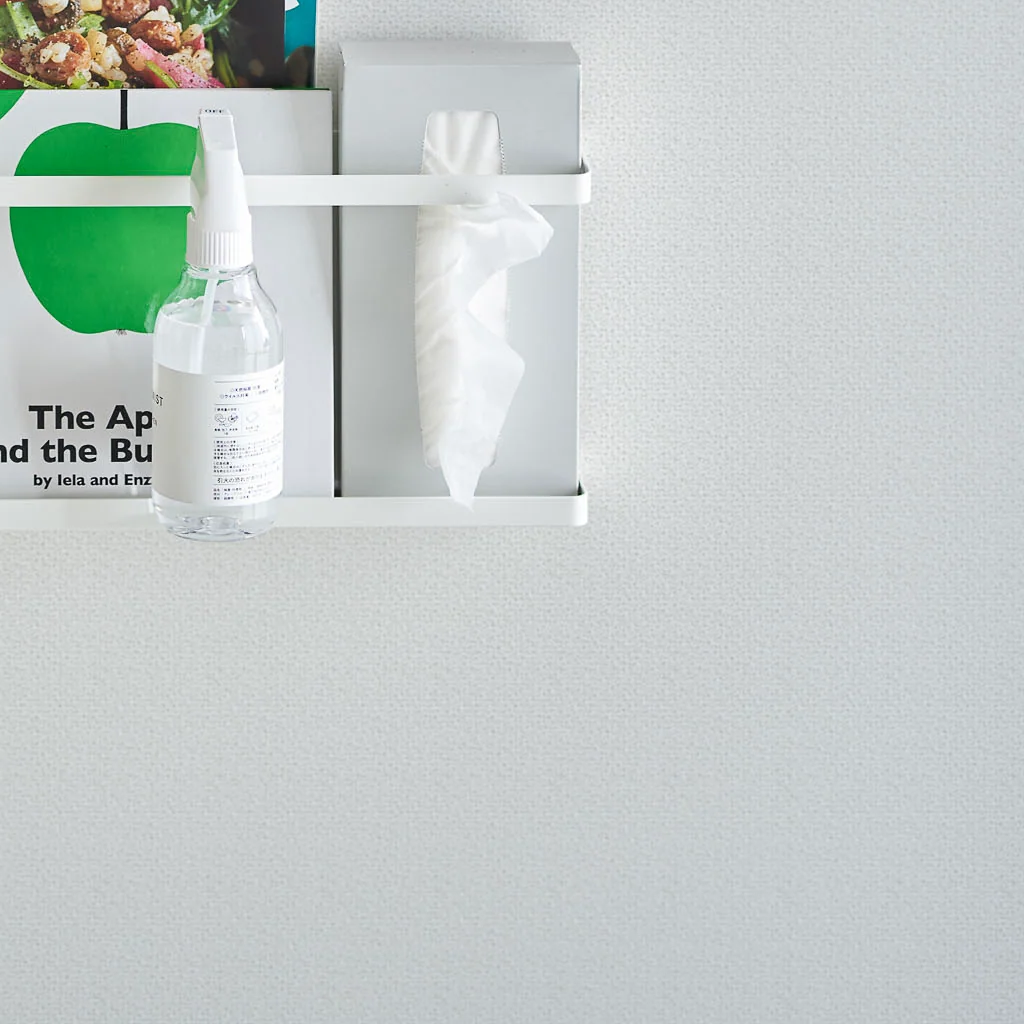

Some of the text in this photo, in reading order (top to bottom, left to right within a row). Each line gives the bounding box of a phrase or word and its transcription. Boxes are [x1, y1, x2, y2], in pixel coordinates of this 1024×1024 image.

[28, 405, 95, 430] The
[40, 439, 98, 464] the
[33, 474, 53, 489] by
[90, 474, 119, 486] and
